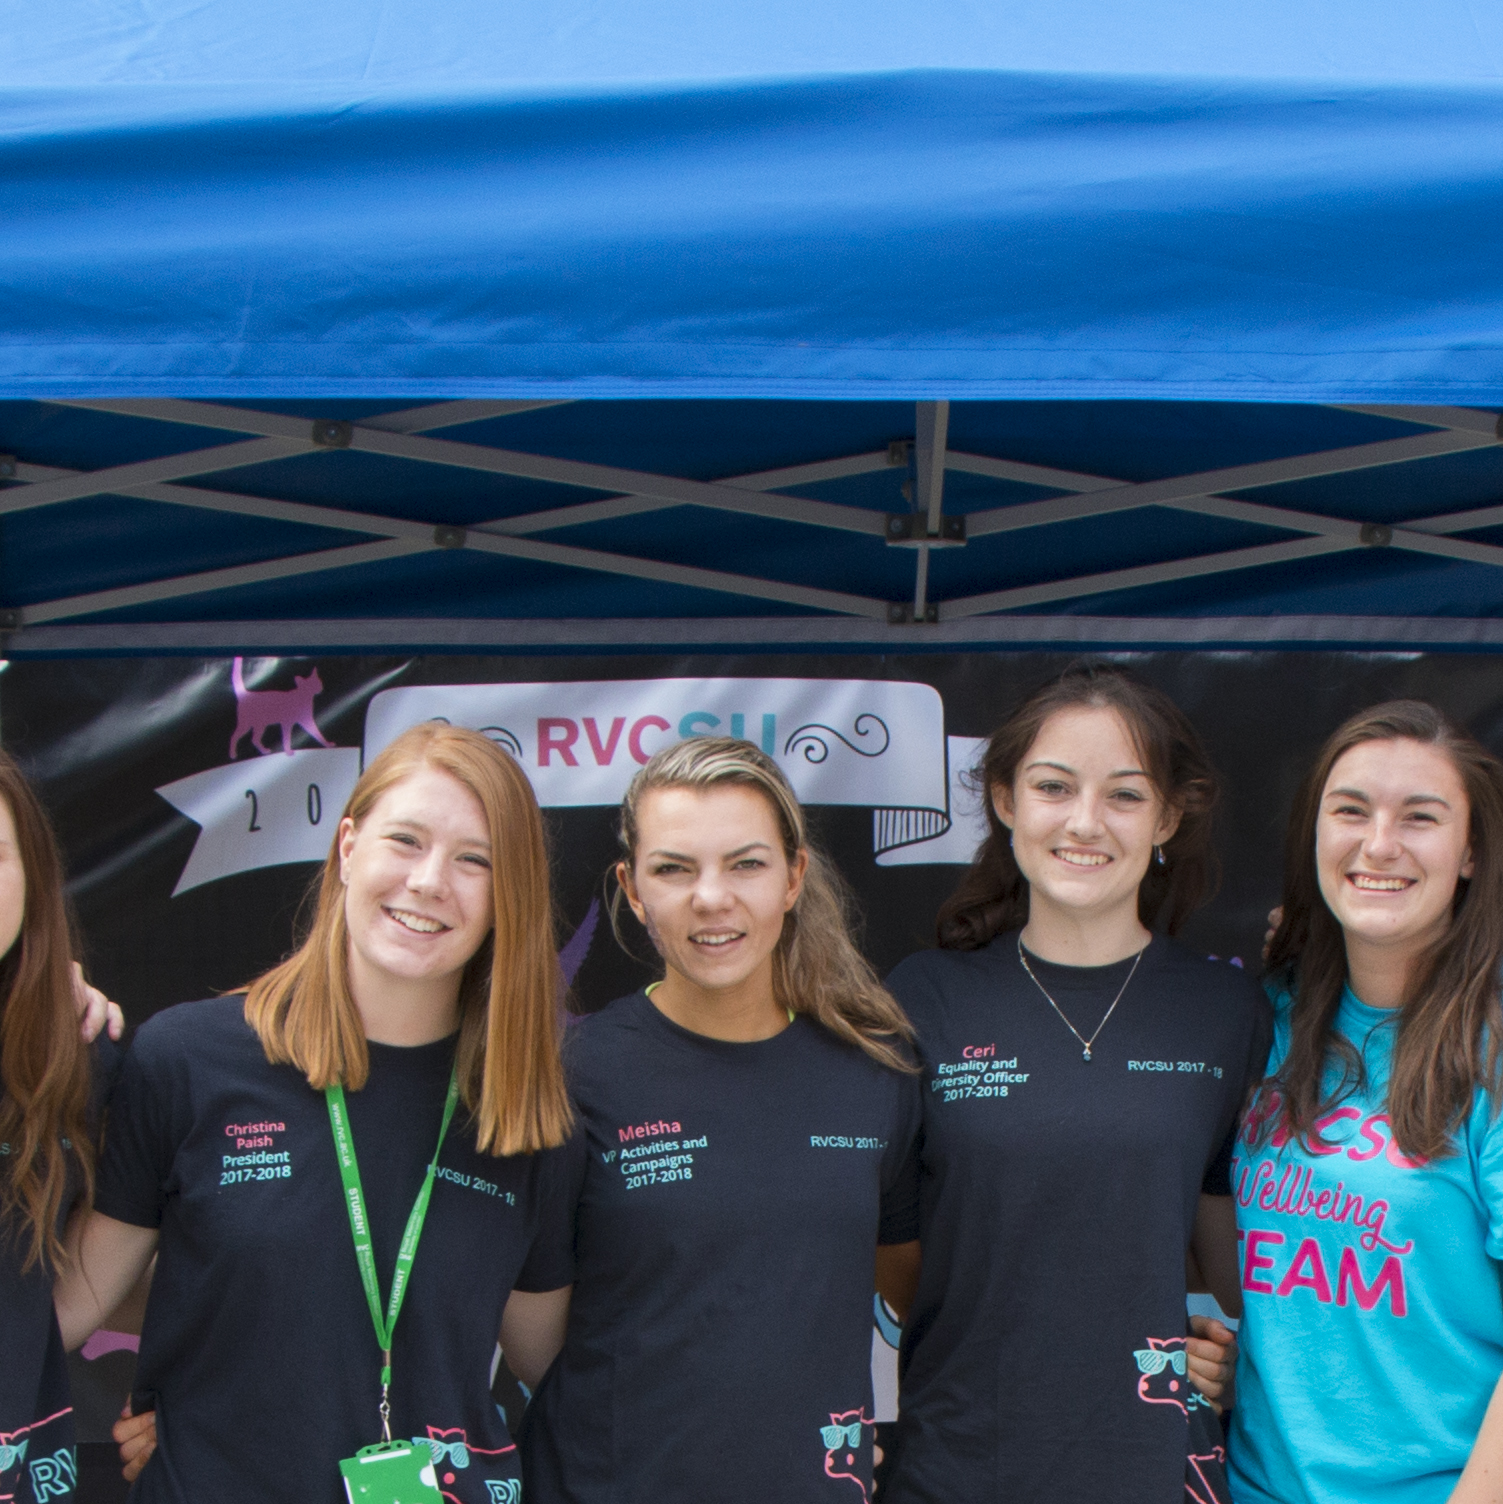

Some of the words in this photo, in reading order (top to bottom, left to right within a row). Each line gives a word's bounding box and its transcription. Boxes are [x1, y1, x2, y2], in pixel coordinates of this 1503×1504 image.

[962, 1043, 996, 1059] Ceri
[938, 1060, 990, 1076] Equality
[991, 1057, 1018, 1070] and
[1127, 1060, 1175, 1072] RVCSU
[1176, 1061, 1205, 1073] 2017
[931, 1073, 981, 1092] Diversity
[983, 1071, 1030, 1085] Officer
[943, 1086, 1010, 1103] 2017-2018
[225, 1120, 286, 1137] Christina
[332, 1102, 352, 1168] www.rvc.ac.uk
[618, 1120, 682, 1143] Meisha
[236, 1135, 274, 1150] Paish
[601, 1150, 617, 1164] VP
[620, 1140, 680, 1160] Activities
[681, 1135, 708, 1150] and
[809, 1135, 854, 1149] RVCSU
[854, 1137, 879, 1149] 2017
[222, 1150, 291, 1168] President
[621, 1154, 694, 1175] Campaigns
[219, 1165, 292, 1186] 2017-2018
[625, 1167, 693, 1190] 2017-2018
[472, 1177, 498, 1197] 2017
[348, 1187, 366, 1236] STUDENT
[1231, 1157, 1415, 1255] Wellbeing
[1237, 1229, 1407, 1318] EAM
[388, 1268, 406, 1316] STUDENT
